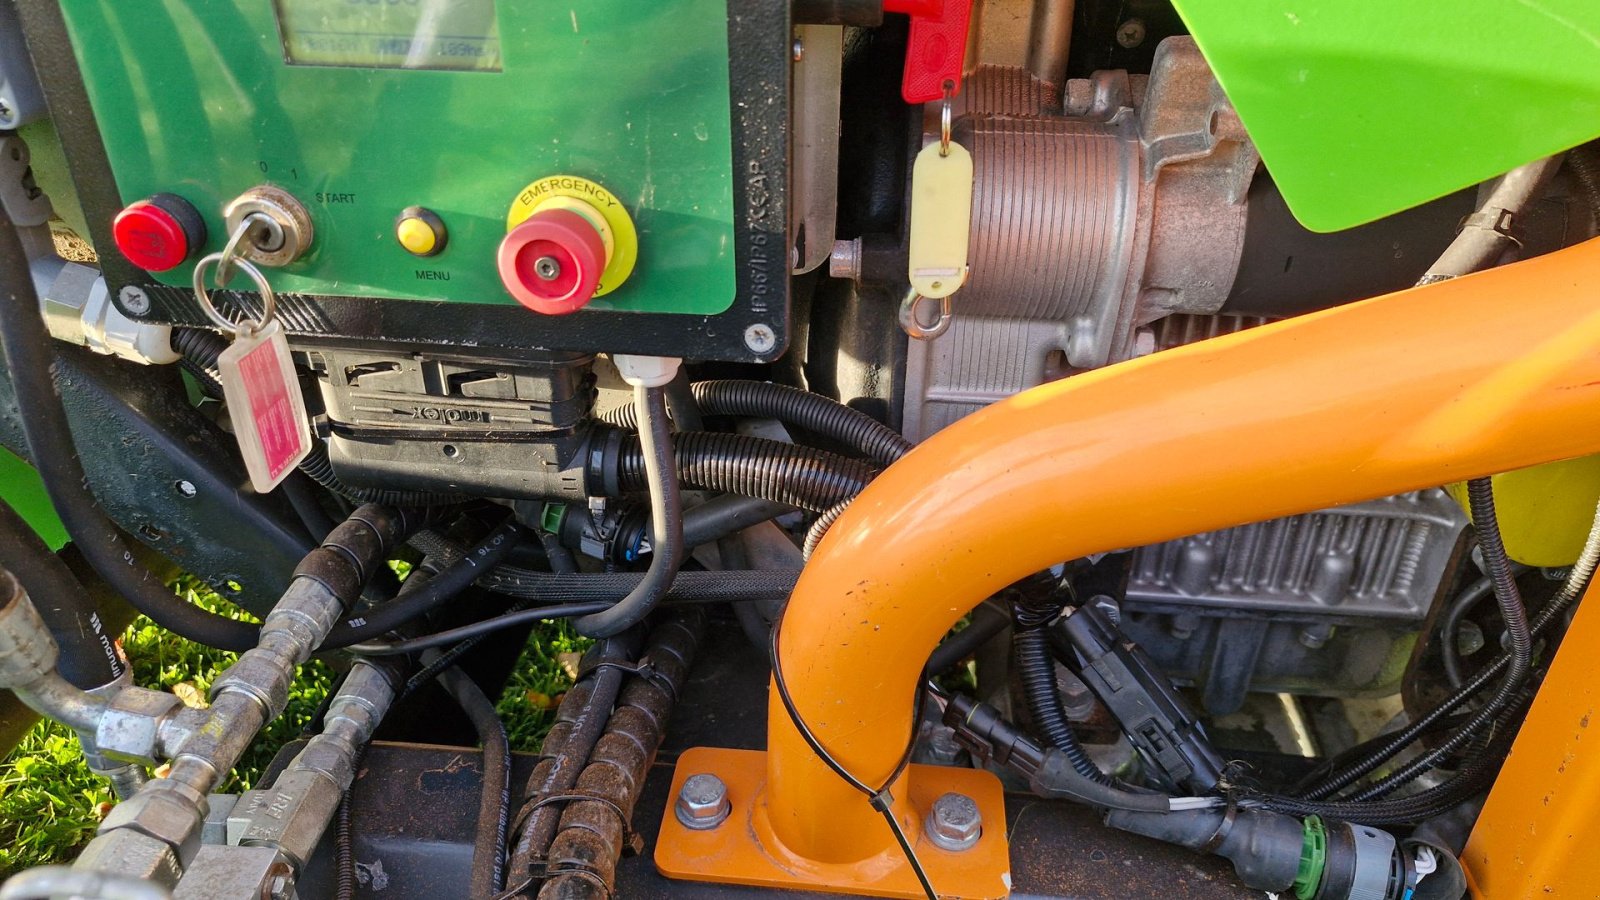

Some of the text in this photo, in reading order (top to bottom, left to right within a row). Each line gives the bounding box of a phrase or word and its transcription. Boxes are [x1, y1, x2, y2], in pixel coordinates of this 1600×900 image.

[259, 161, 268, 173] 0
[290, 168, 298, 180] 1
[315, 192, 356, 204] START
[520, 177, 616, 209] EMERGENCY
[415, 270, 451, 281] MENU
[412, 406, 483, 425] molex
[100, 634, 122, 679] manuli
